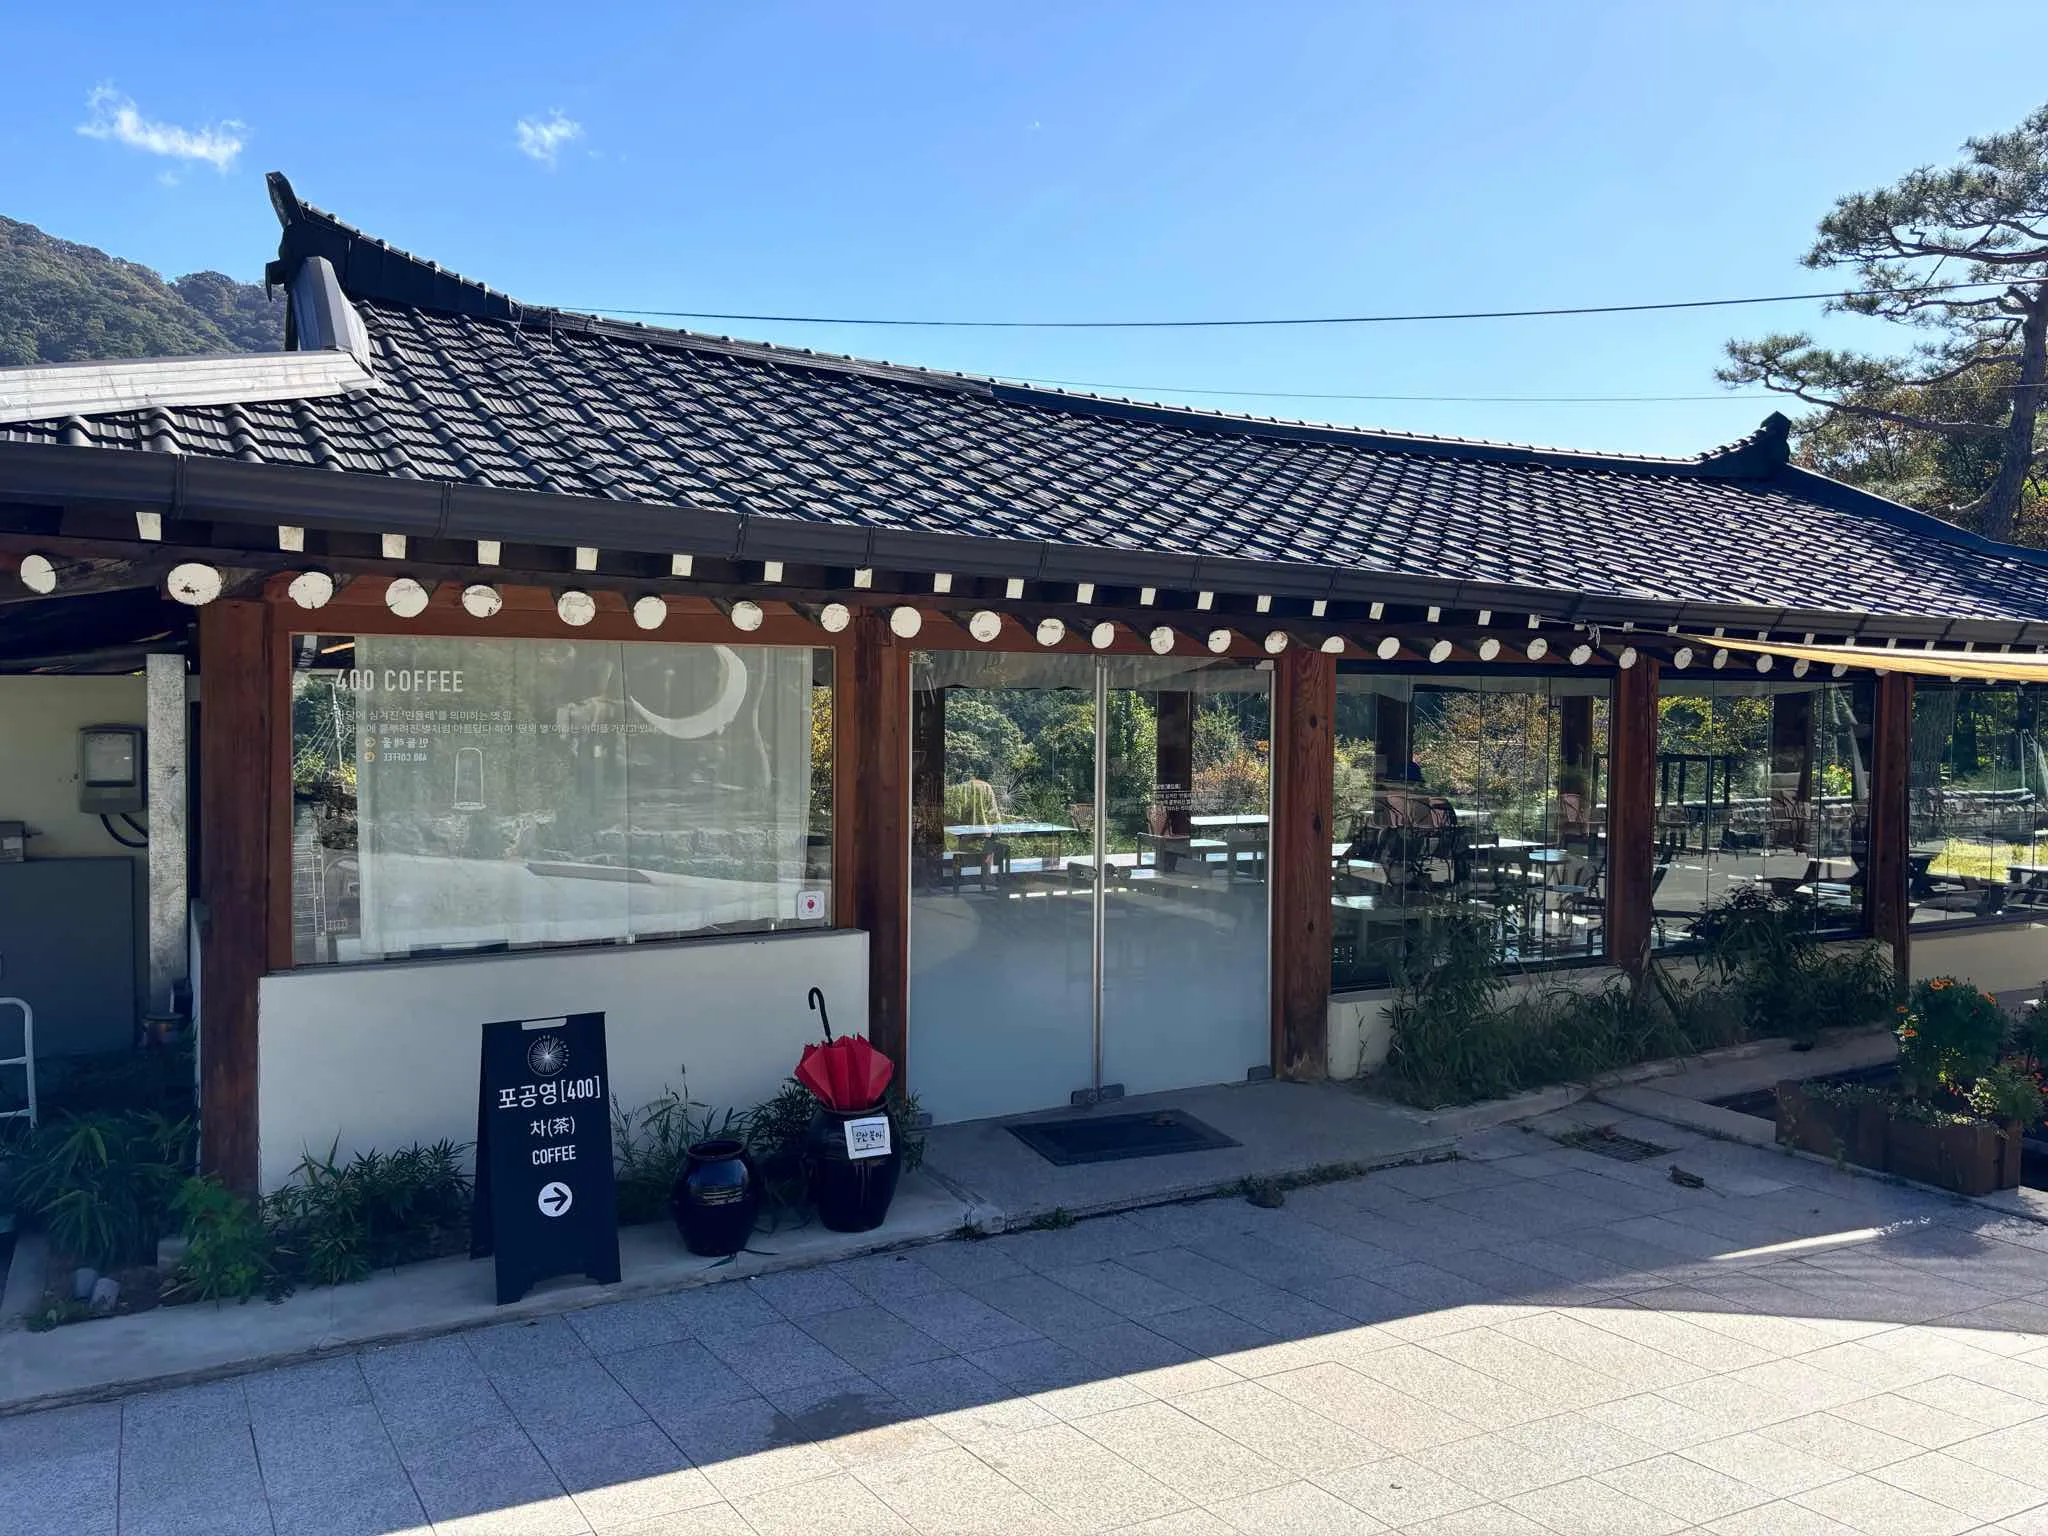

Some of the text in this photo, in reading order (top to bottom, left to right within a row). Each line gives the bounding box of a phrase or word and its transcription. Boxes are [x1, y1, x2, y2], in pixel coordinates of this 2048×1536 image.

[335, 669, 464, 693] 400 COFFEE
[498, 1075, 601, 1110] 포공영[400]
[529, 1116, 576, 1138] 차(茶)
[531, 1144, 577, 1166] COFFEE
